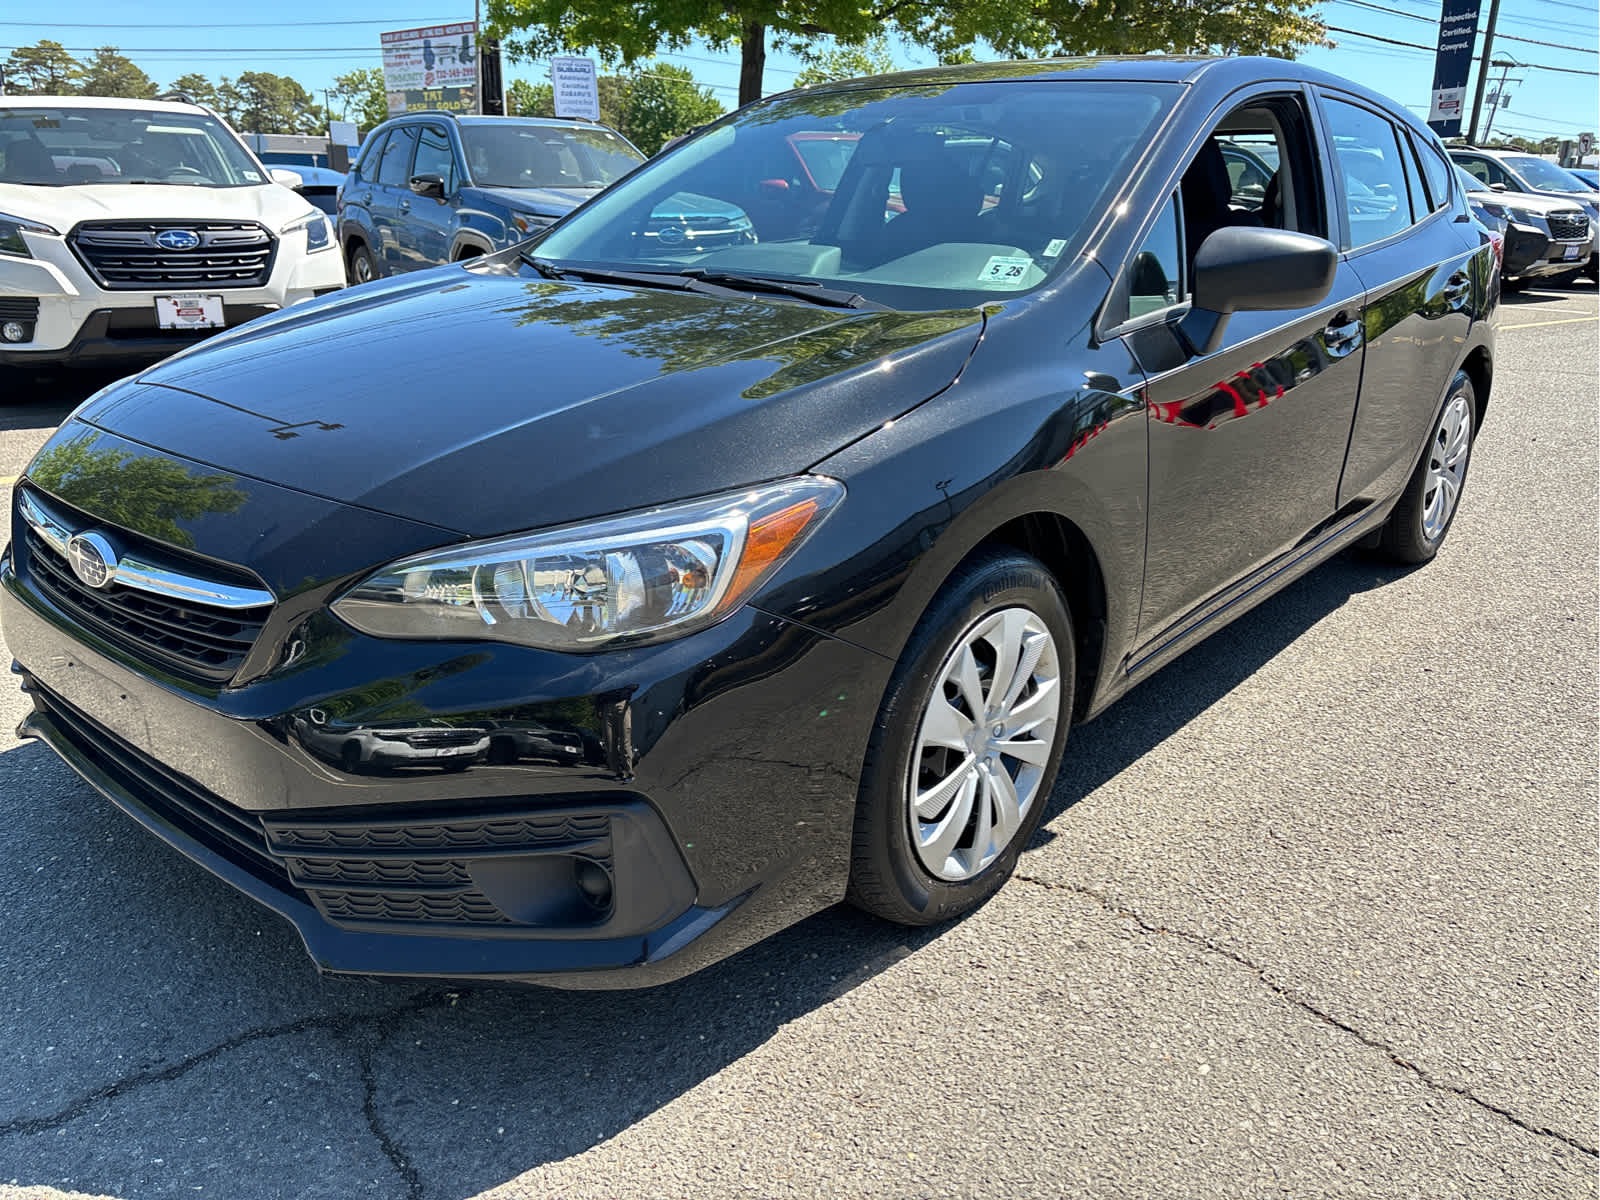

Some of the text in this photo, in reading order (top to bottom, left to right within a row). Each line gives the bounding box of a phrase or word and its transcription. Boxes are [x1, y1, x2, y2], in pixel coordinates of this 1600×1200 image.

[1443, 10, 1478, 23] Inspected.
[1441, 26, 1473, 37] Certified.
[437, 101, 460, 111] GOLD
[990, 264, 1024, 277] 5 28
